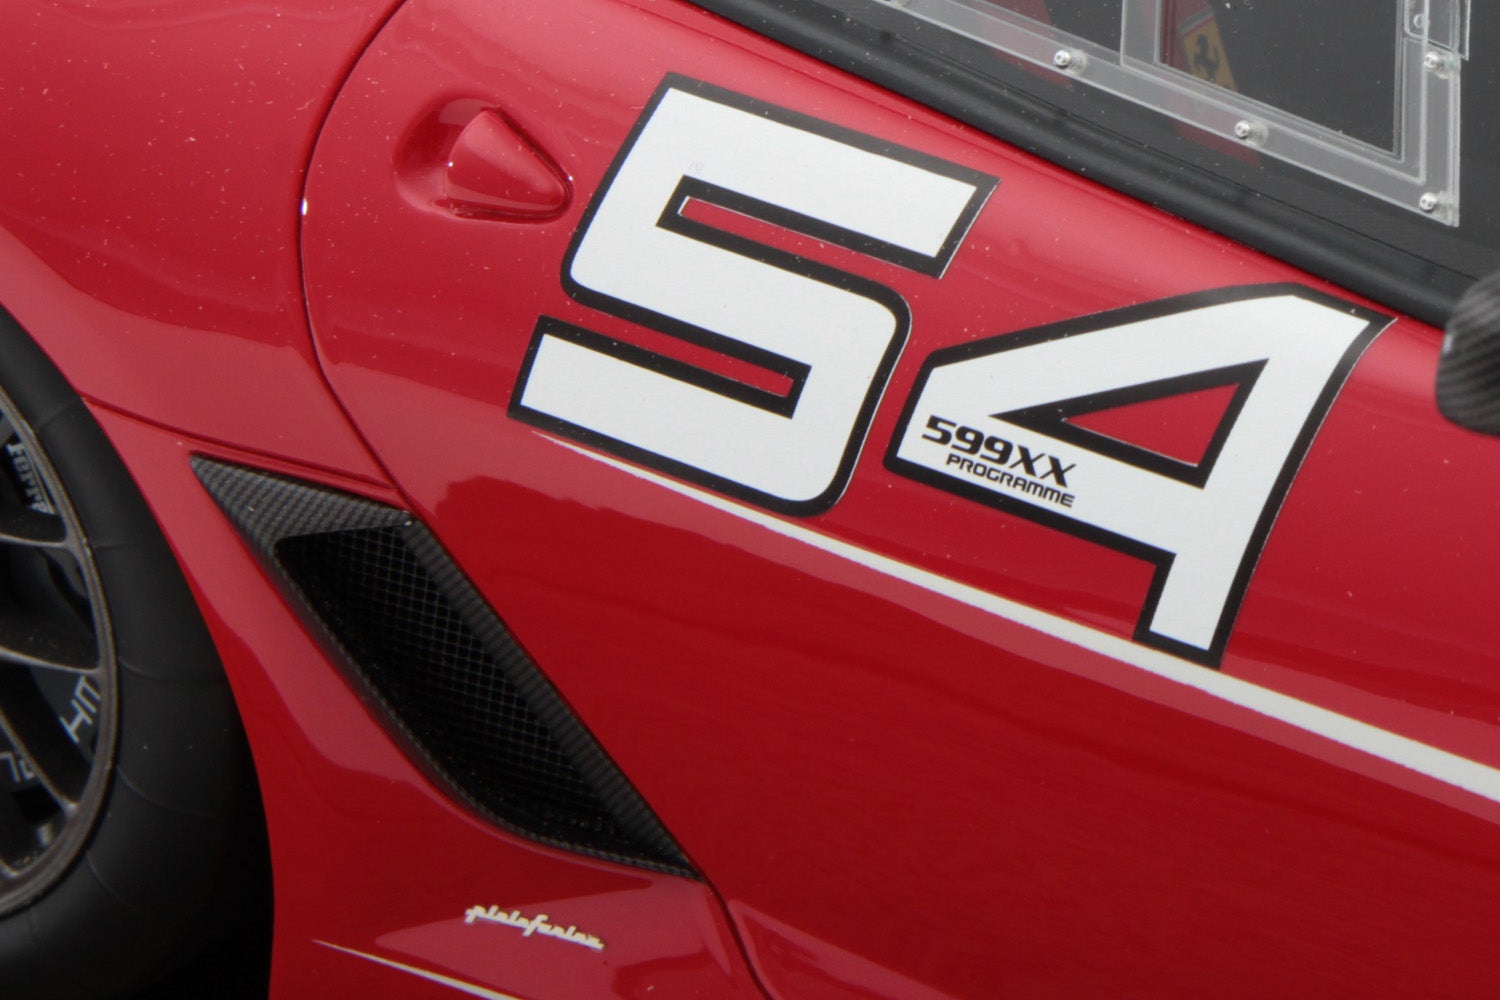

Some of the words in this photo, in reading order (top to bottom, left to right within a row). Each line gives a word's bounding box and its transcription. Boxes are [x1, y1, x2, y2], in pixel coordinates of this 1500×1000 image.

[508, 74, 1396, 668] 54
[921, 414, 1077, 488] 599XX
[946, 453, 1075, 508] PROGRAMME
